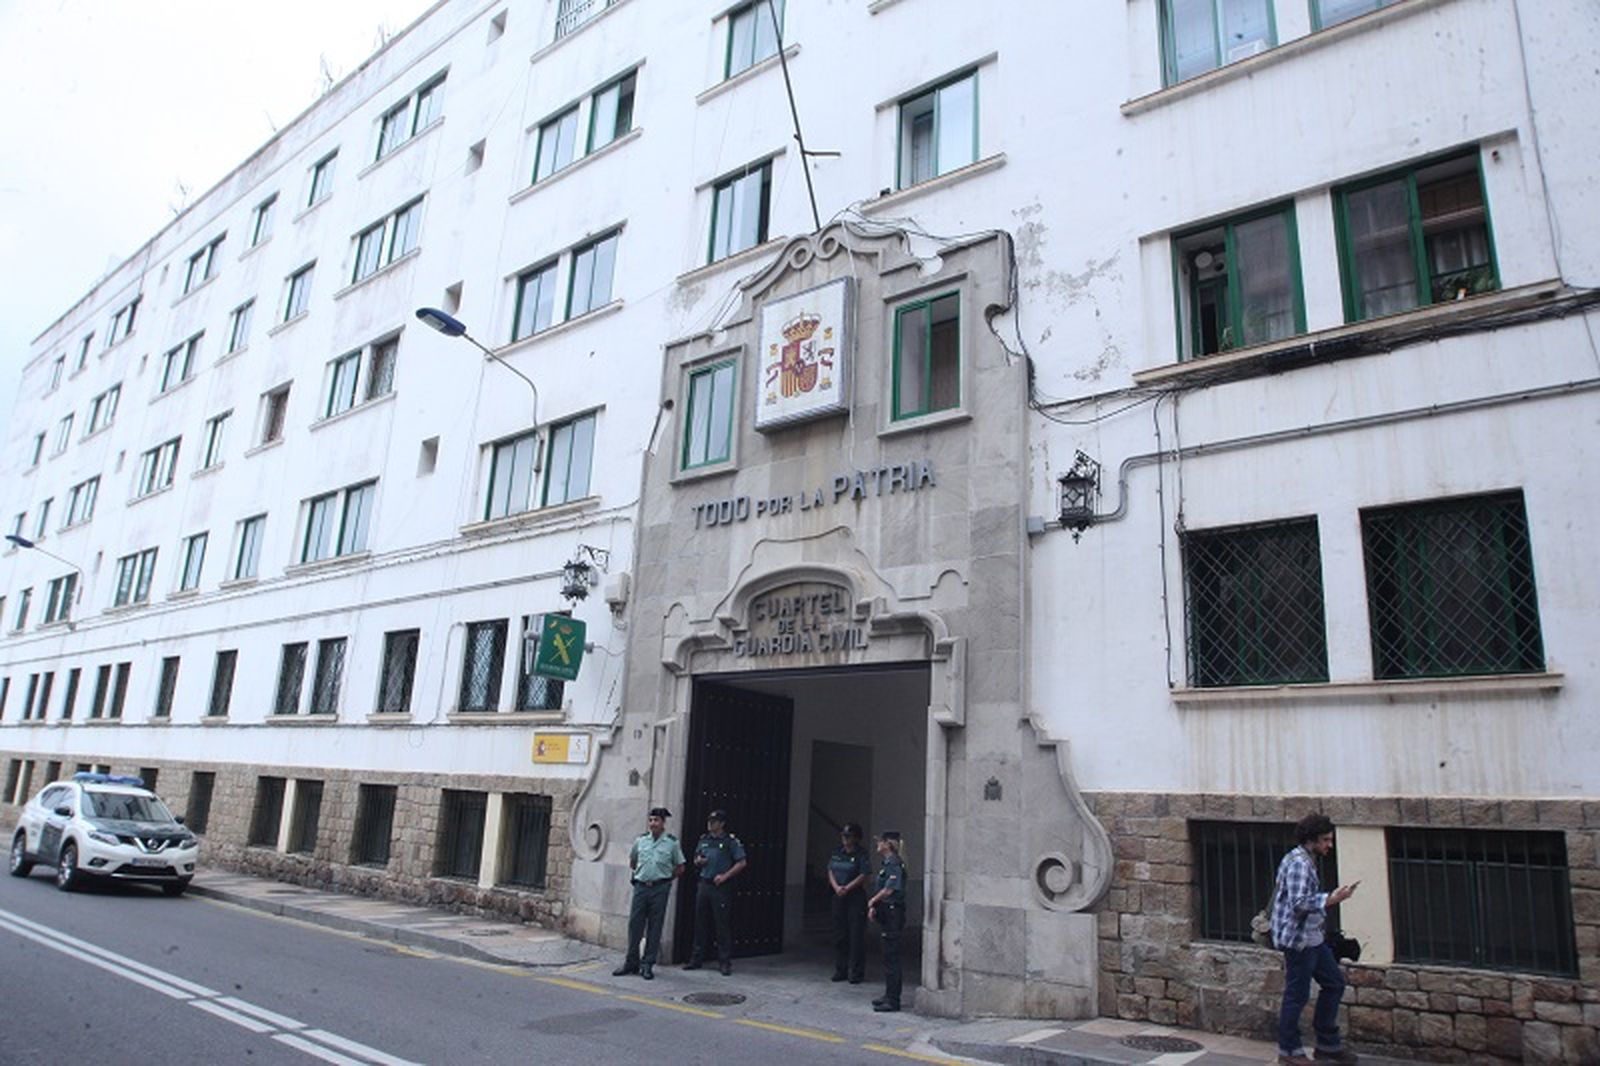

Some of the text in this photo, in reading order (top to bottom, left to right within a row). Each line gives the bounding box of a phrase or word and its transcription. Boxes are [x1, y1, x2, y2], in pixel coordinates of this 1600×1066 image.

[691, 458, 937, 530] TODO POR LA PATRIA
[754, 591, 846, 621] CUARTEL
[778, 615, 821, 635] DE LA
[733, 627, 869, 658] GUARDIA CIVIL
